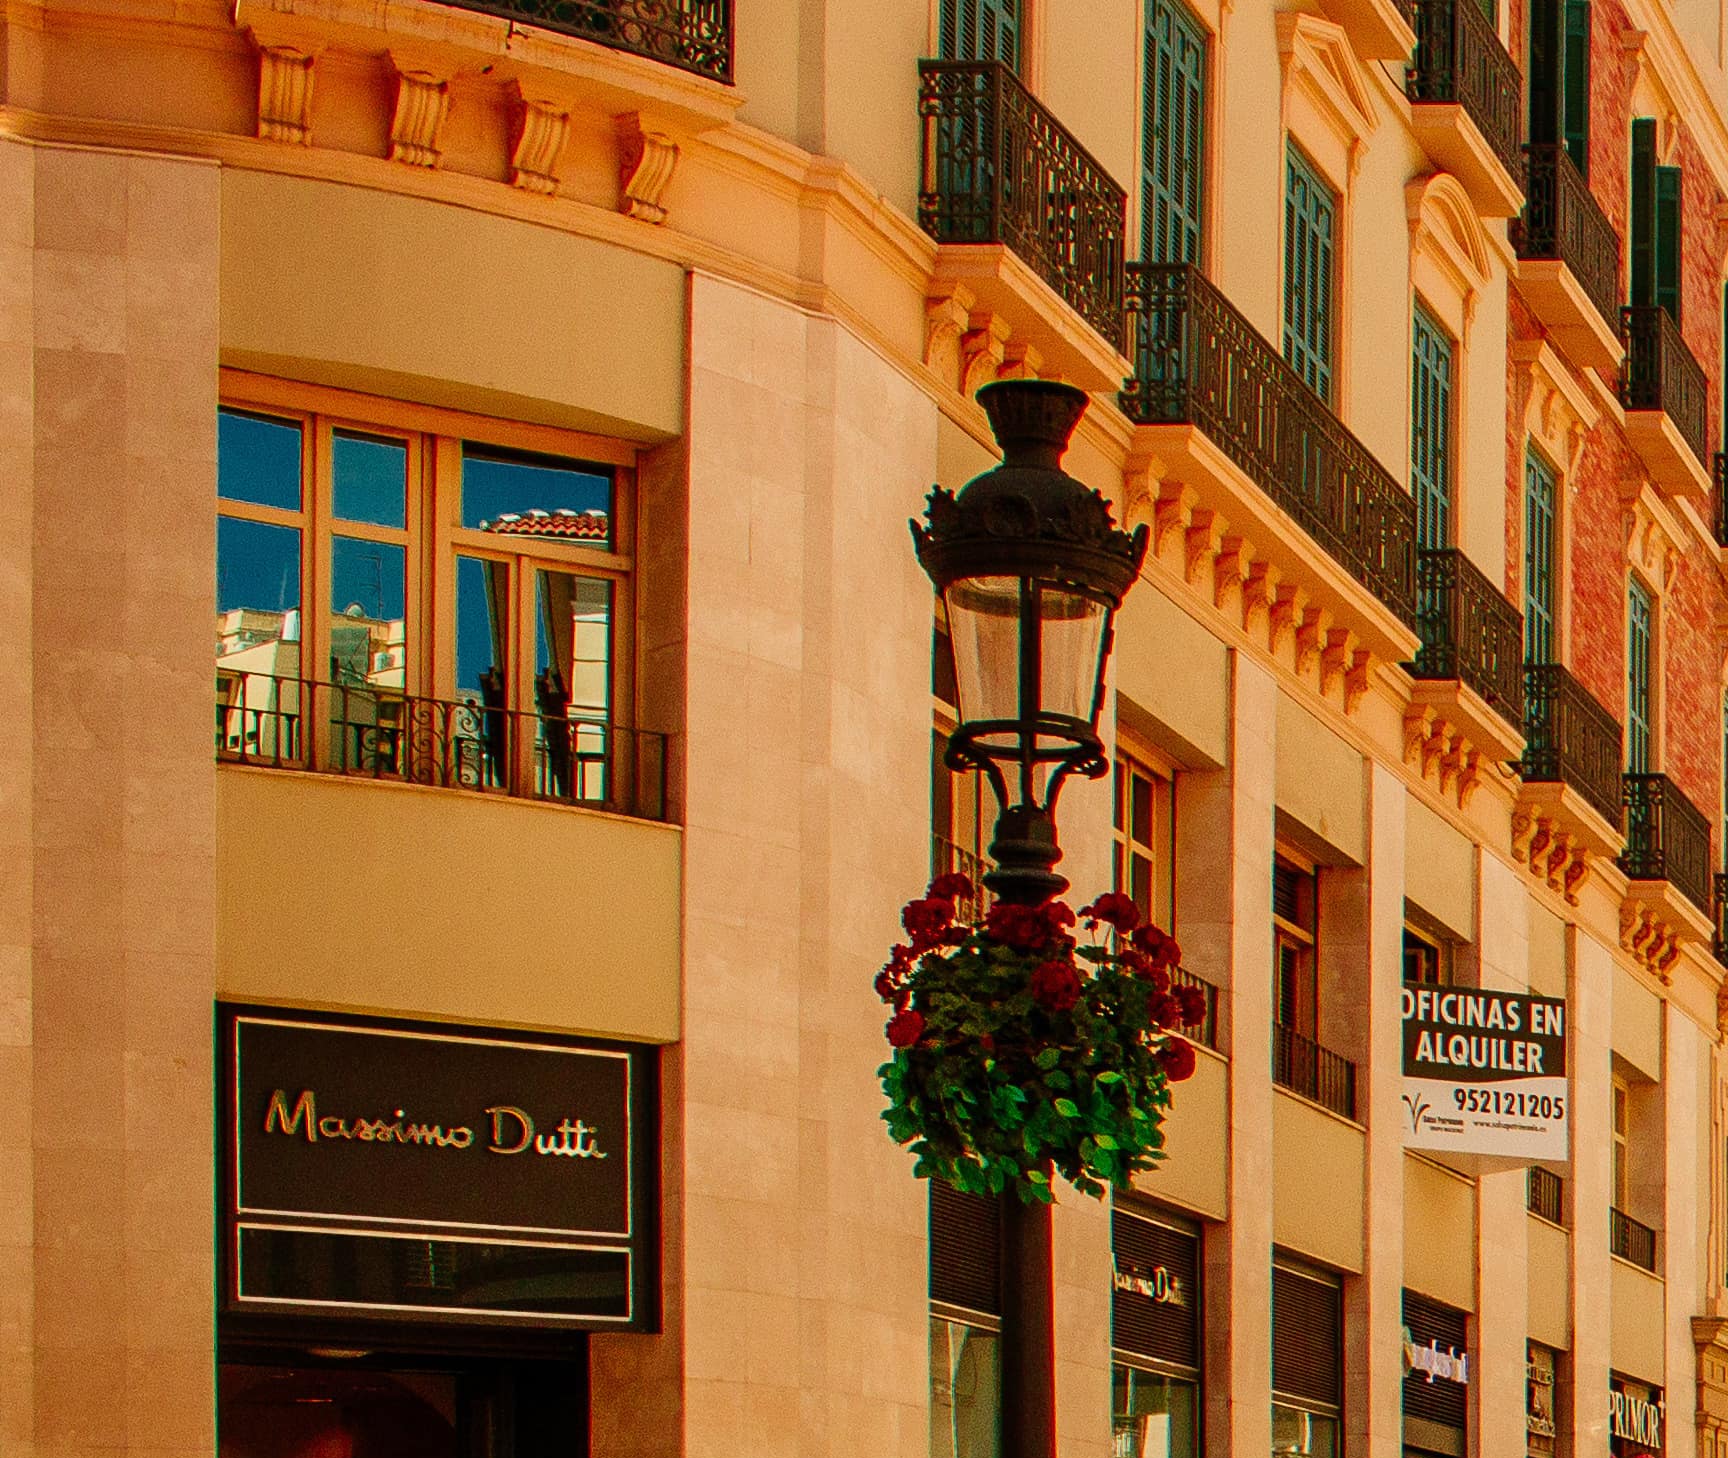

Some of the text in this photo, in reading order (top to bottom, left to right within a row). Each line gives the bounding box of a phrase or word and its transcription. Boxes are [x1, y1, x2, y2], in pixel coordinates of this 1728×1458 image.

[1401, 988, 1563, 1036] OFICINAS EN
[1415, 1030, 1545, 1074] ALQUILER
[264, 1089, 609, 1159] Massimo Dutti
[1453, 1088, 1565, 1120] 952121205
